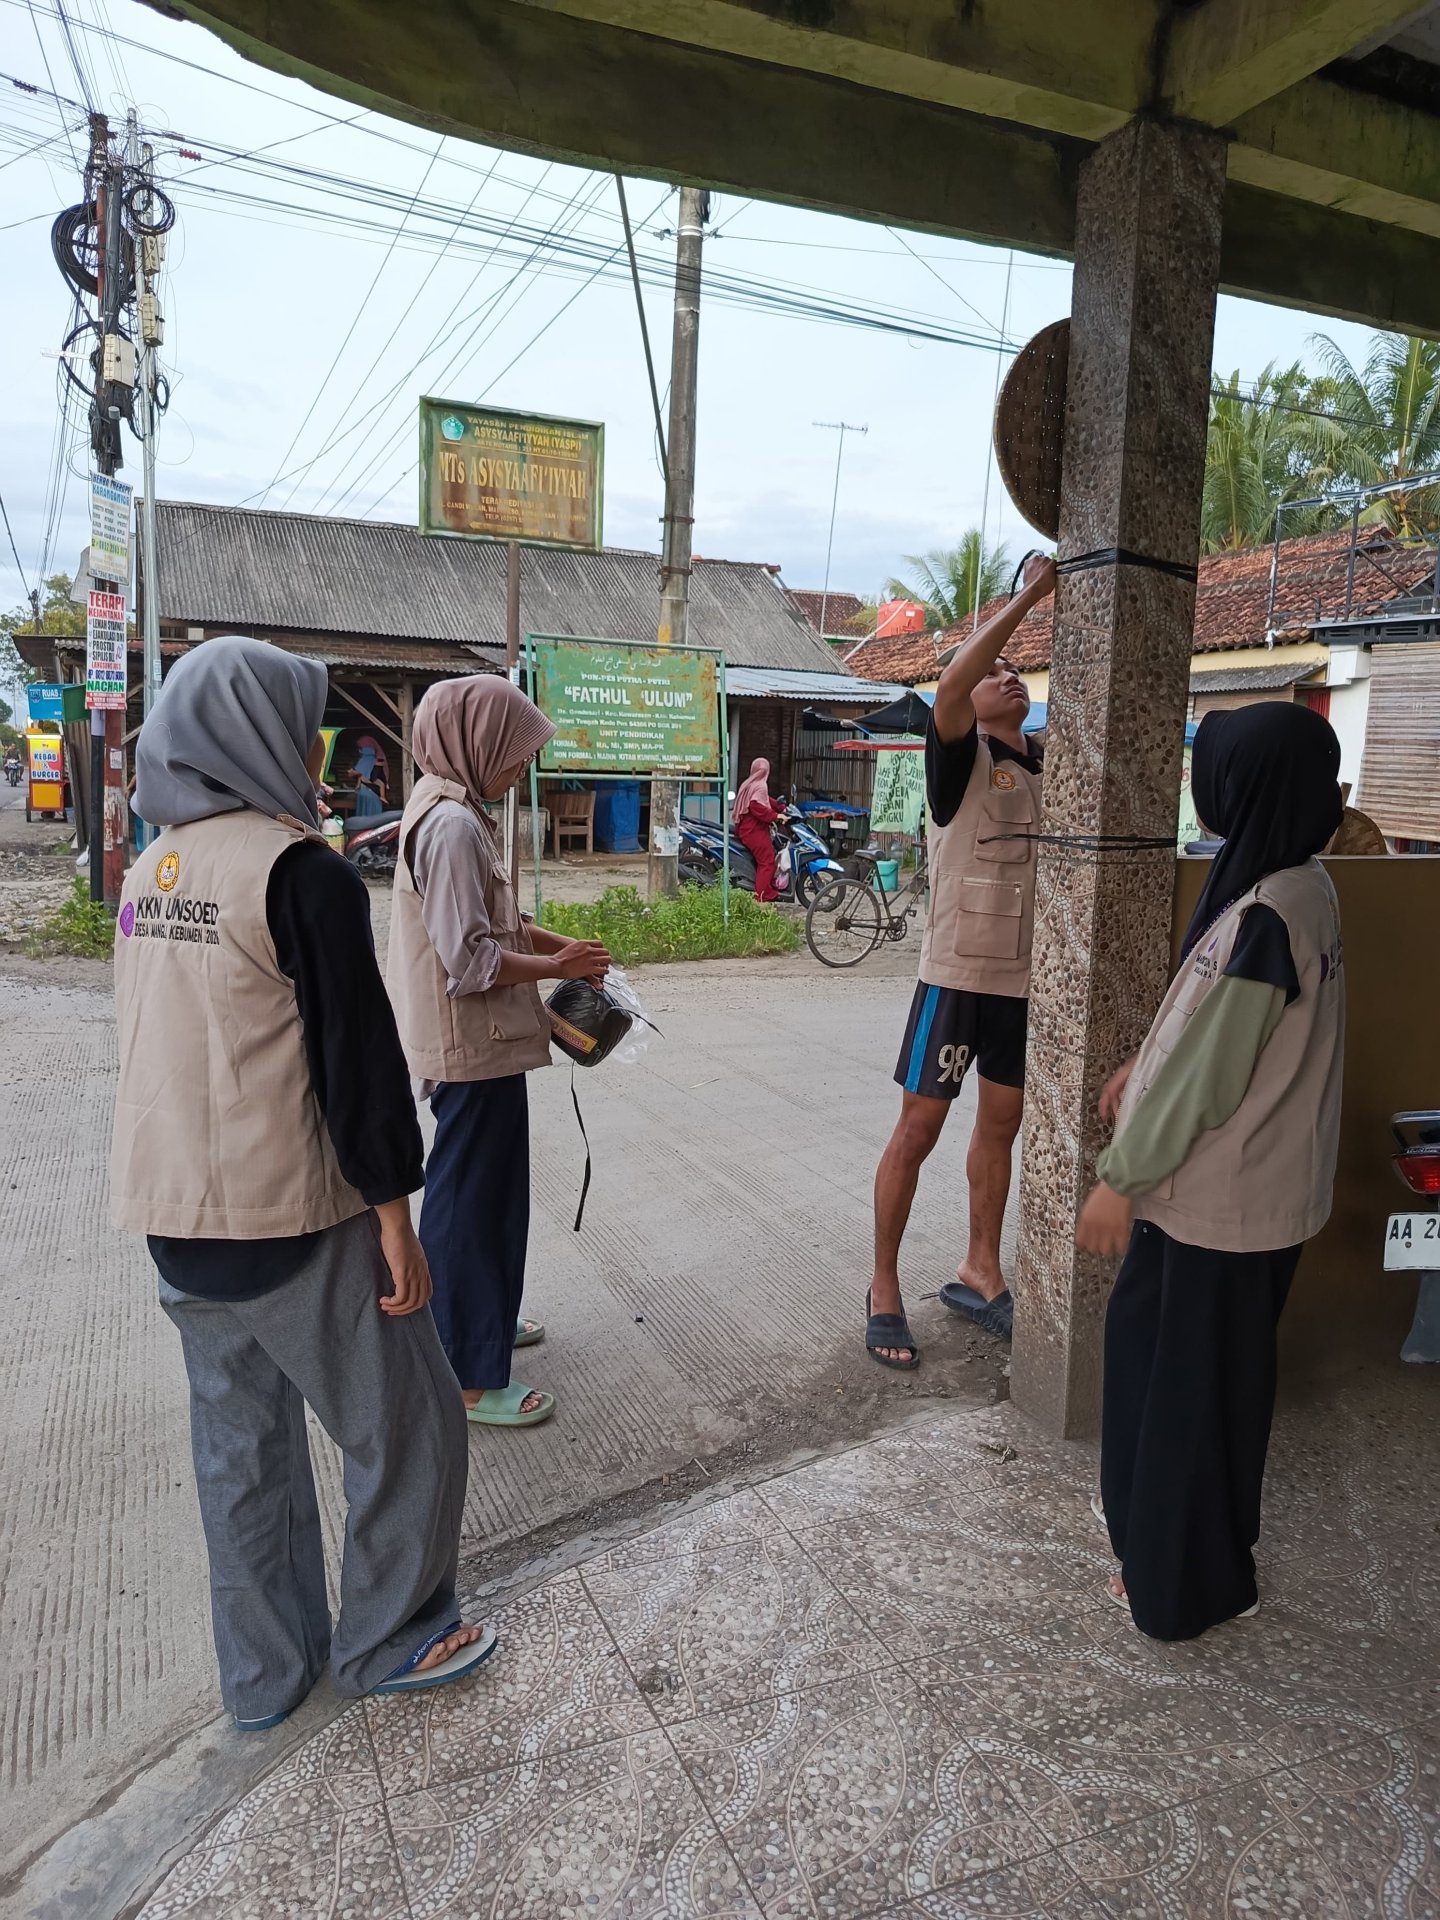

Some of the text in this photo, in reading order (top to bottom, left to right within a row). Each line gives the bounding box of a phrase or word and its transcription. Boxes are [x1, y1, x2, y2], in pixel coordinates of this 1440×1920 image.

[467, 416, 507, 428] YAYASAN
[508, 423, 562, 437] PENDIDIKAN
[439, 452, 466, 484] MTs
[89, 591, 125, 611] TERAPI
[42, 689, 59, 697] RUAS
[87, 681, 125, 692] NACHAN
[600, 729, 665, 739] UNIT PENDIDIKAN
[34, 752, 57, 761] KEBAB
[32, 770, 60, 778] BURGER
[136, 896, 220, 925] KKN UNSOED
[134, 923, 149, 937] DESA
[168, 925, 203, 943] KEBUMEN
[937, 1044, 969, 1083] 98
[1388, 1217, 1440, 1240] AA 2
